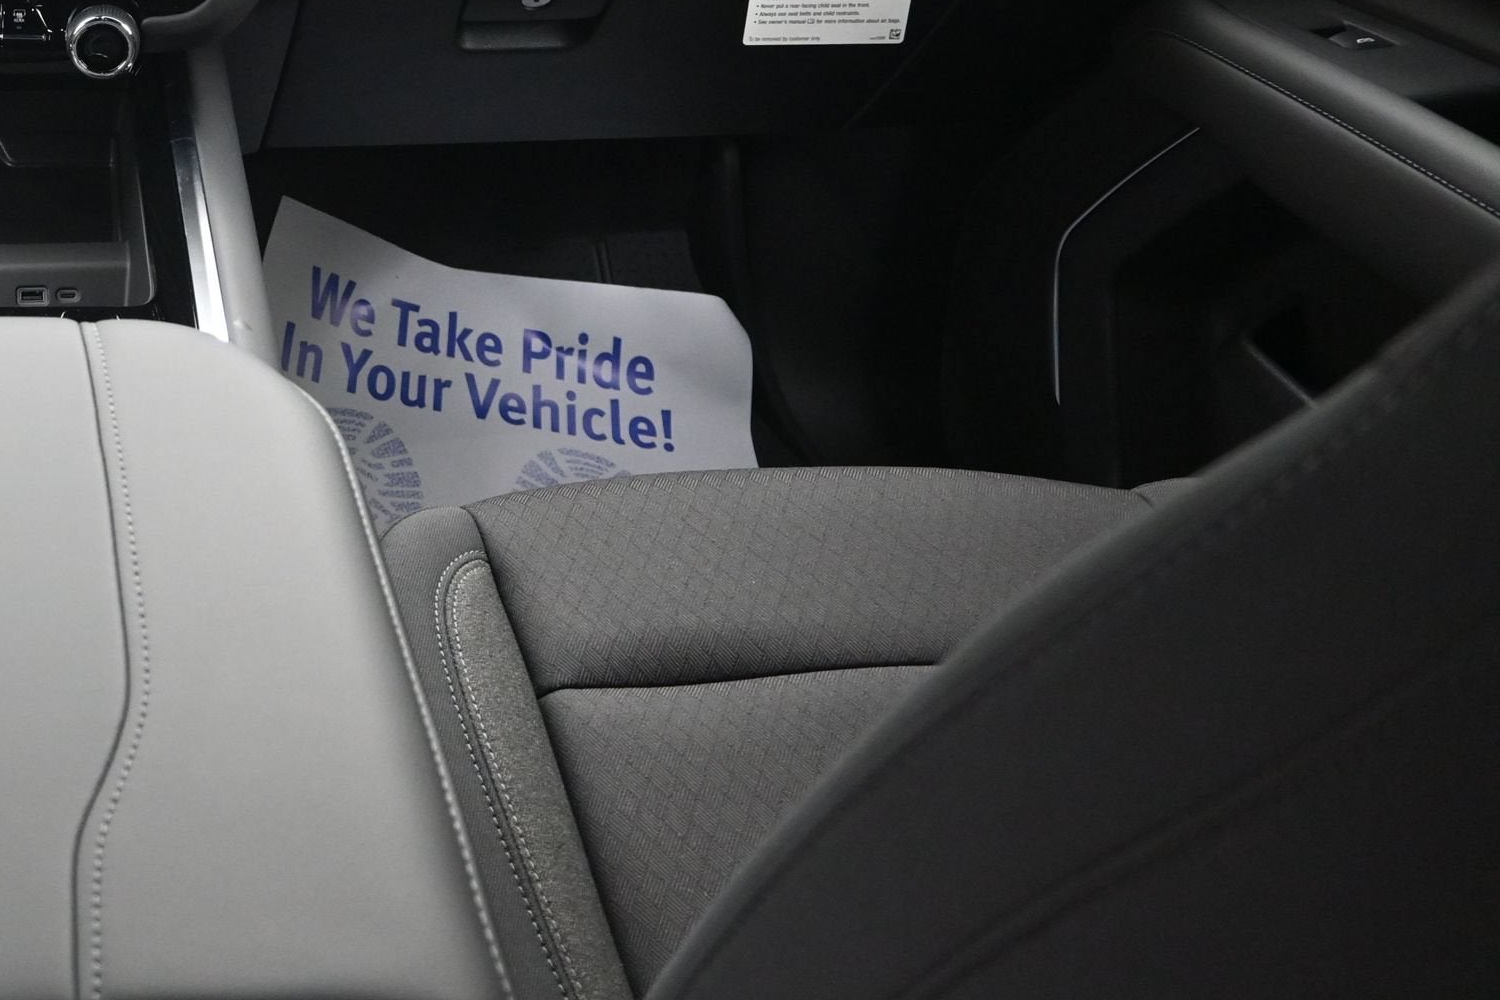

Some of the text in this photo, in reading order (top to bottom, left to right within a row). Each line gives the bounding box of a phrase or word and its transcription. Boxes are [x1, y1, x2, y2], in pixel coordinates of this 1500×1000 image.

[281, 321, 675, 453] In Your Vehicle!
[310, 265, 656, 397] We Take Pride
